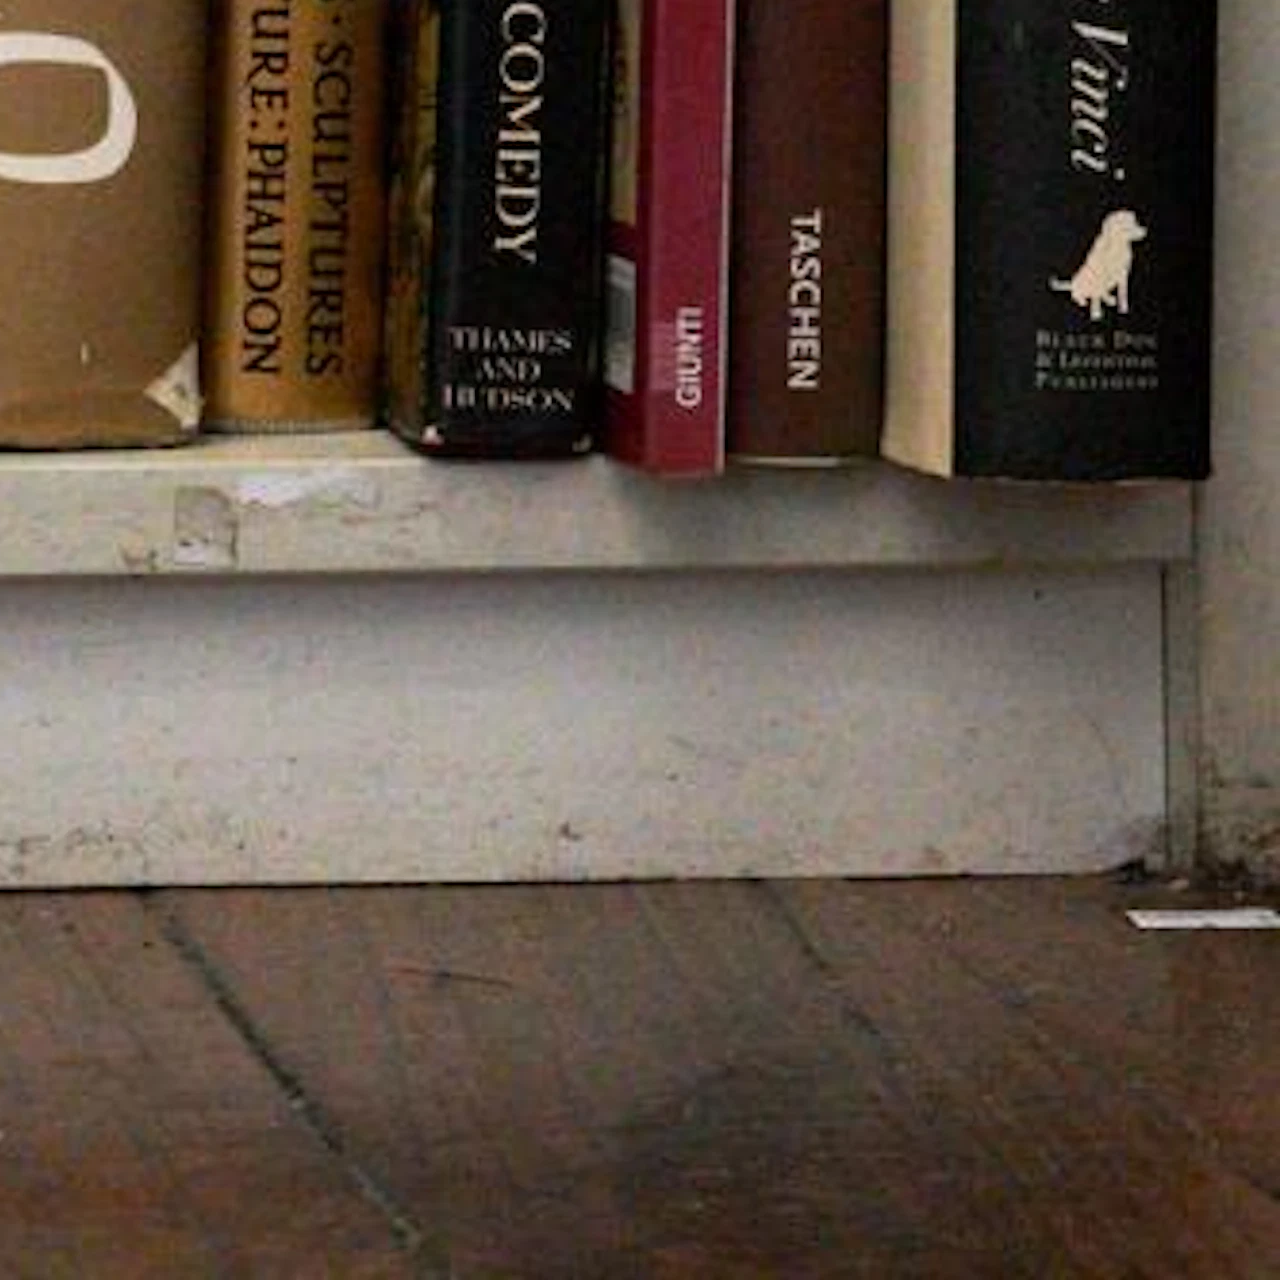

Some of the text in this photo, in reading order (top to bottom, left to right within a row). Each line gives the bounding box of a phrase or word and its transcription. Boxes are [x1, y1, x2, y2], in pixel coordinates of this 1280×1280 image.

[493, 0, 545, 265] COMEDY
[1070, 18, 1130, 181] Vinci
[304, 40, 353, 377] SCULPTURES
[476, 357, 542, 381] AND
[786, 207, 822, 391] TASCHEN
[443, 382, 575, 412] HUDSON
